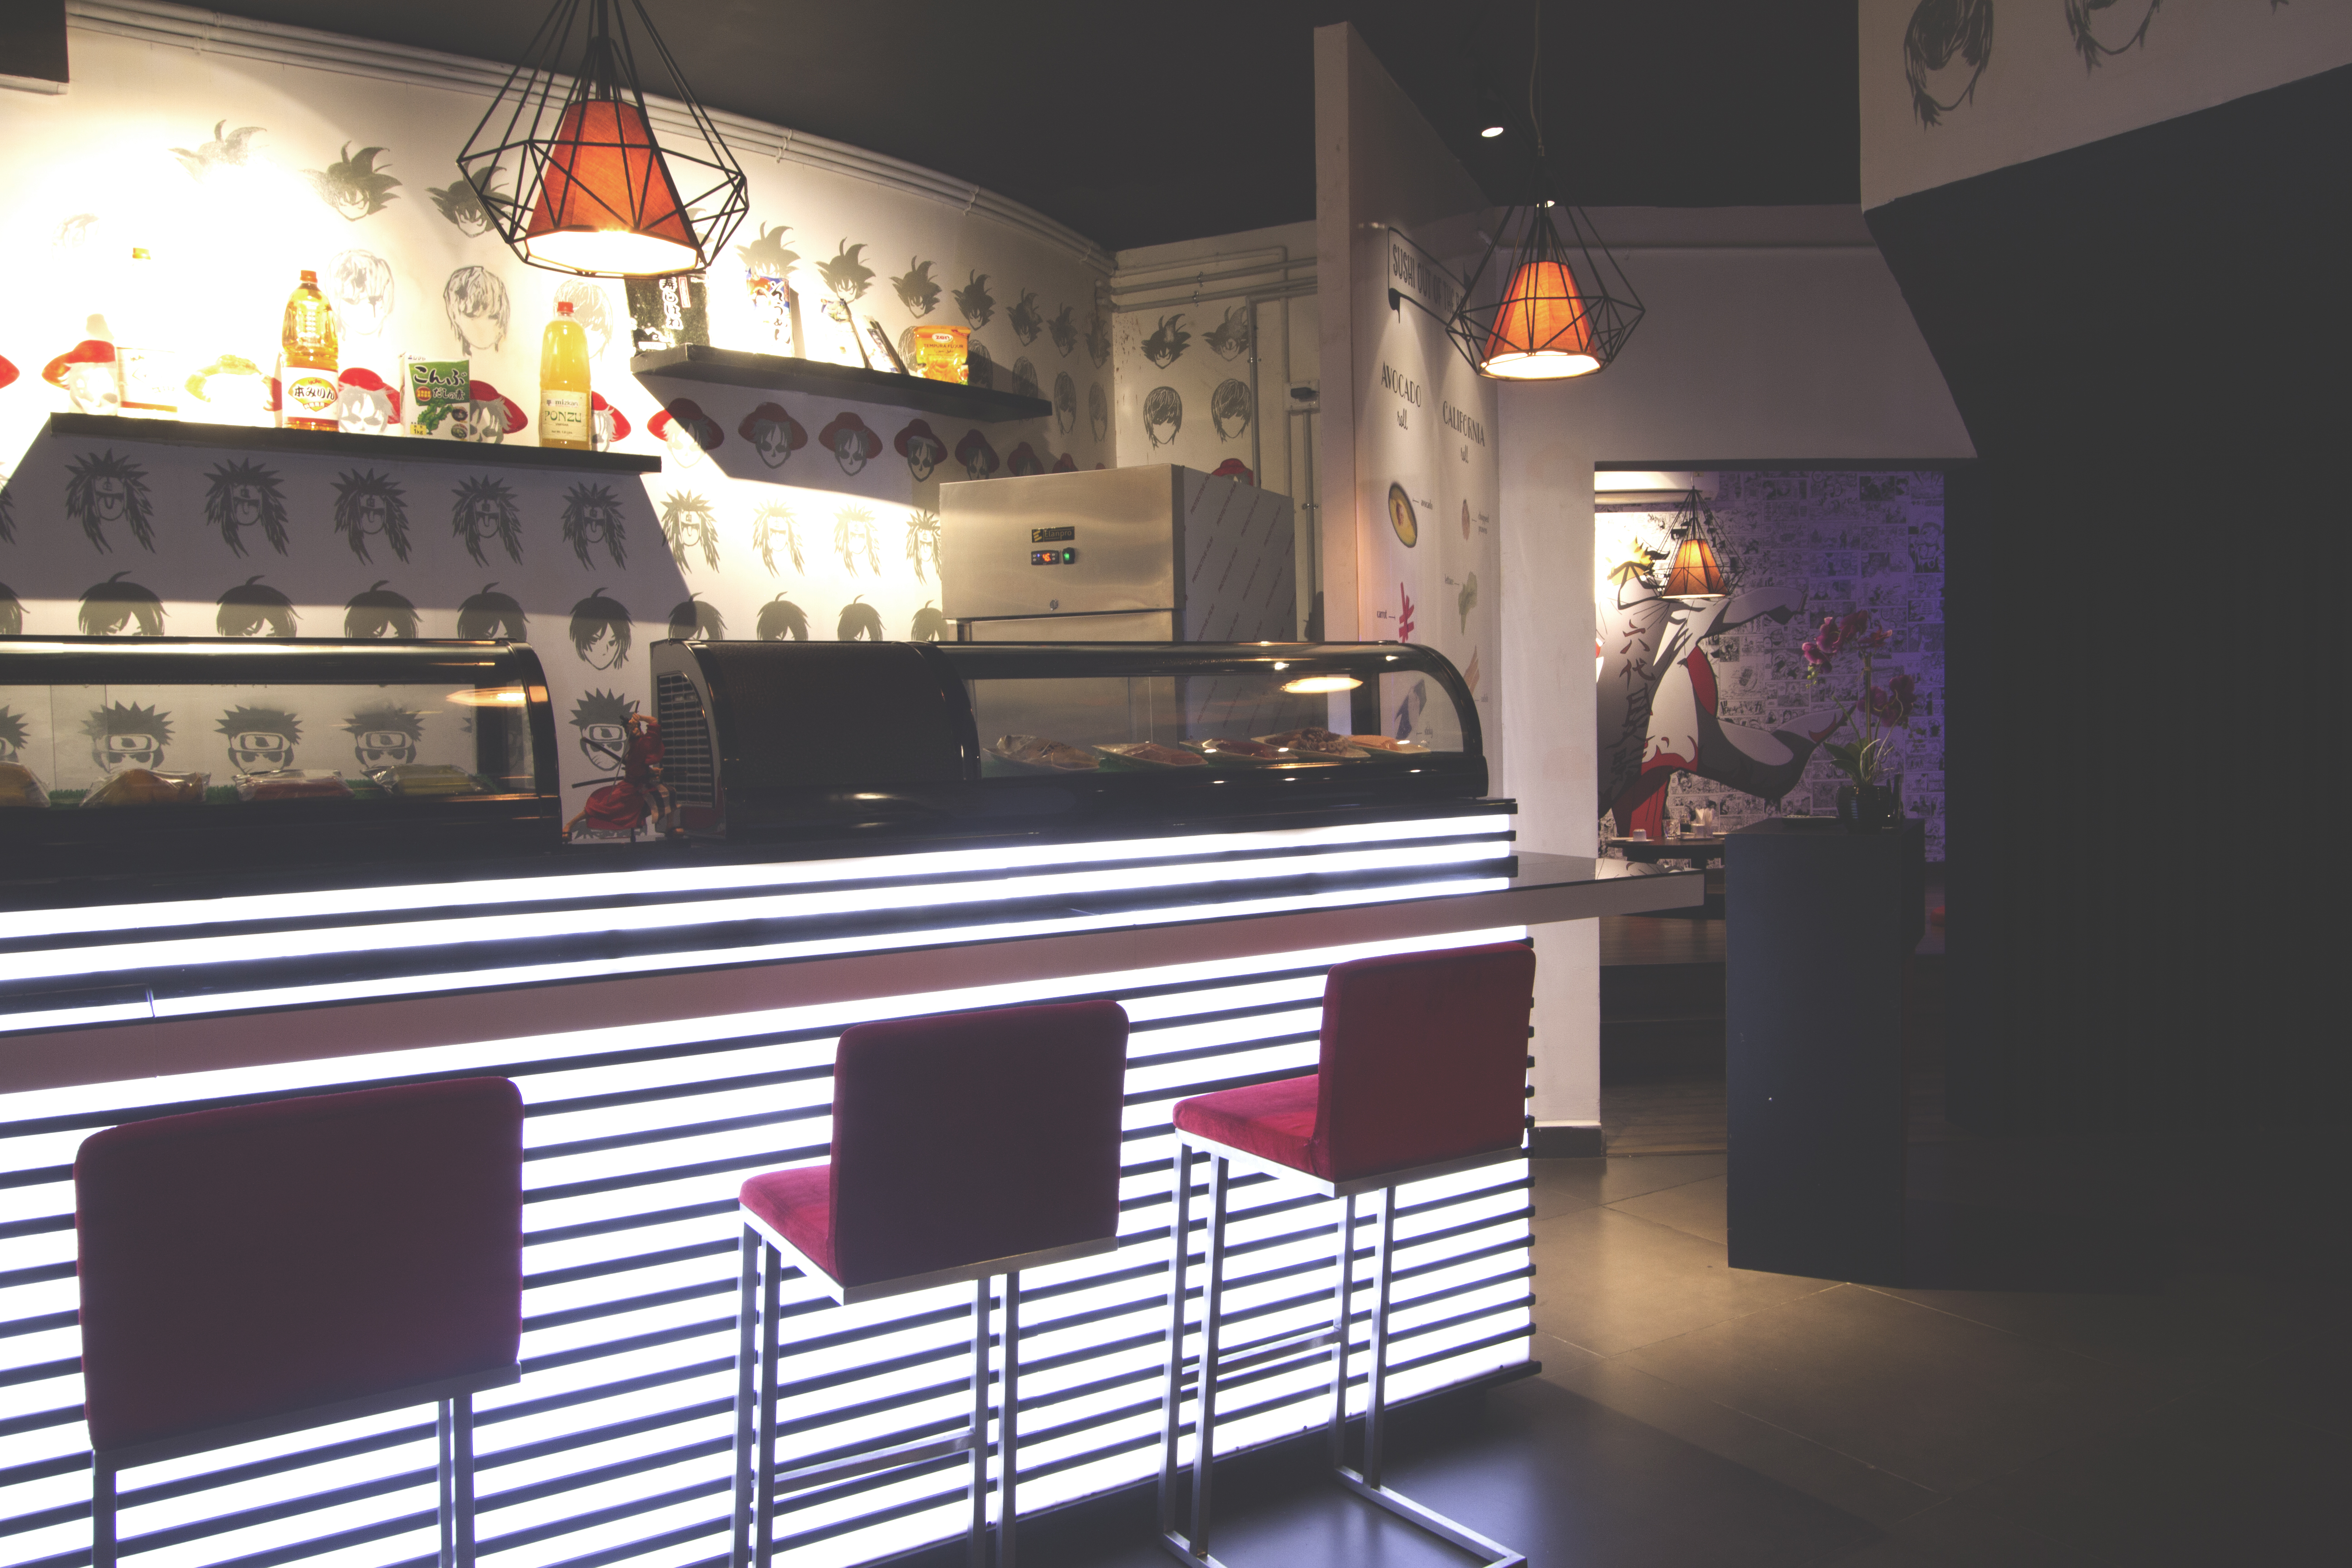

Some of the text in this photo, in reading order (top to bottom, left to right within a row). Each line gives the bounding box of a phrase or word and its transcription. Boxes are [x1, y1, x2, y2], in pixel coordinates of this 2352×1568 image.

[1393, 244, 1415, 289] SUSHI
[1417, 262, 1431, 299] OUT
[1433, 274, 1441, 306] OF
[1443, 280, 1455, 314] THE
[413, 365, 467, 386] こんぶ
[1381, 361, 1421, 407] AVOCADO
[294, 386, 335, 400] 本みりん
[433, 387, 466, 401] だしの素
[544, 410, 582, 422] PONZU
[1397, 408, 1408, 430] roll
[1443, 401, 1485, 447] CALIFORNIA
[1460, 444, 1469, 464] roll
[1044, 530, 1072, 540] Elanpro
